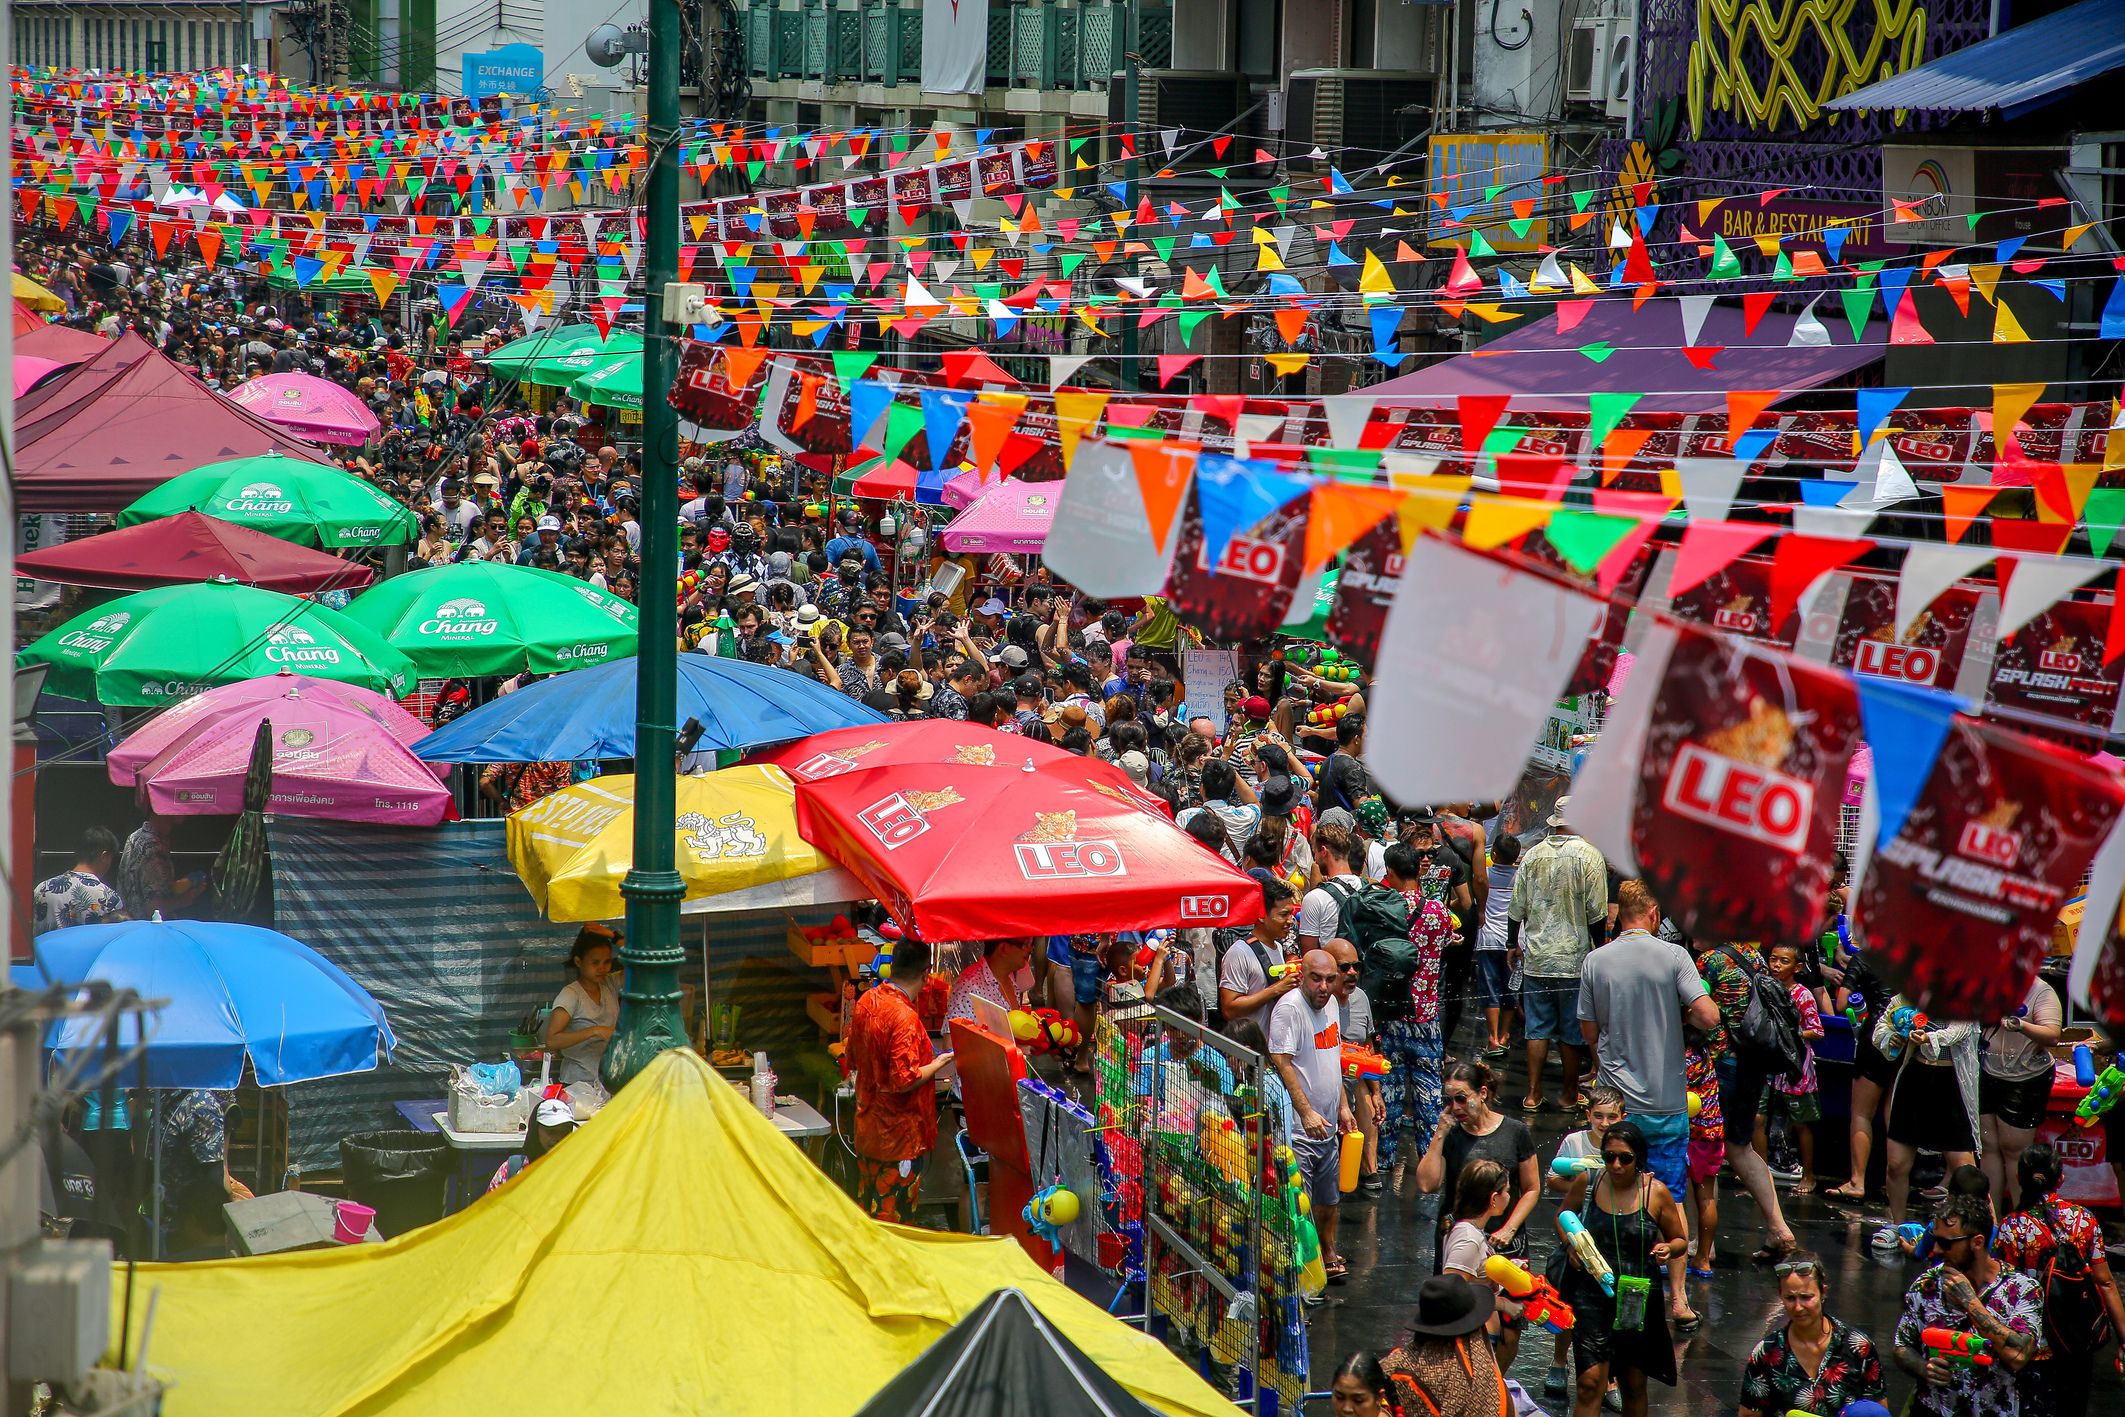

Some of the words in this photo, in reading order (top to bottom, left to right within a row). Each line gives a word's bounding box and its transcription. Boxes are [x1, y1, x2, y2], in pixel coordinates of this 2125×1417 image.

[478, 65, 535, 77] EXCHANGE
[987, 172, 1009, 182] LEO
[903, 190, 925, 199] LEO
[1724, 209, 1752, 236] BAR
[1755, 213, 1765, 235] &
[1931, 220, 1951, 231] OFFICE
[2014, 217, 2031, 230] house
[1430, 432, 1454, 442] LEO
[1899, 438, 1951, 458] LEO
[226, 498, 292, 514] Chang
[351, 526, 381, 538] Chang
[418, 619, 498, 636] Chang
[1718, 610, 1753, 629] LEO
[58, 630, 112, 654] Chang
[573, 643, 608, 658] Chang
[265, 646, 340, 664] Chang
[1187, 652, 1204, 663] LEO
[1857, 643, 1937, 682] LEO
[2042, 651, 2079, 670] LEO
[1218, 666, 1232, 676] 150
[396, 800, 419, 811] 1115
[1679, 757, 1801, 837] LEO
[859, 794, 926, 846] LEO
[1966, 827, 2016, 862] LEO
[1020, 841, 1123, 877] LEO
[1184, 897, 1227, 917] LEO
[2056, 1141, 2093, 1158] LEO
